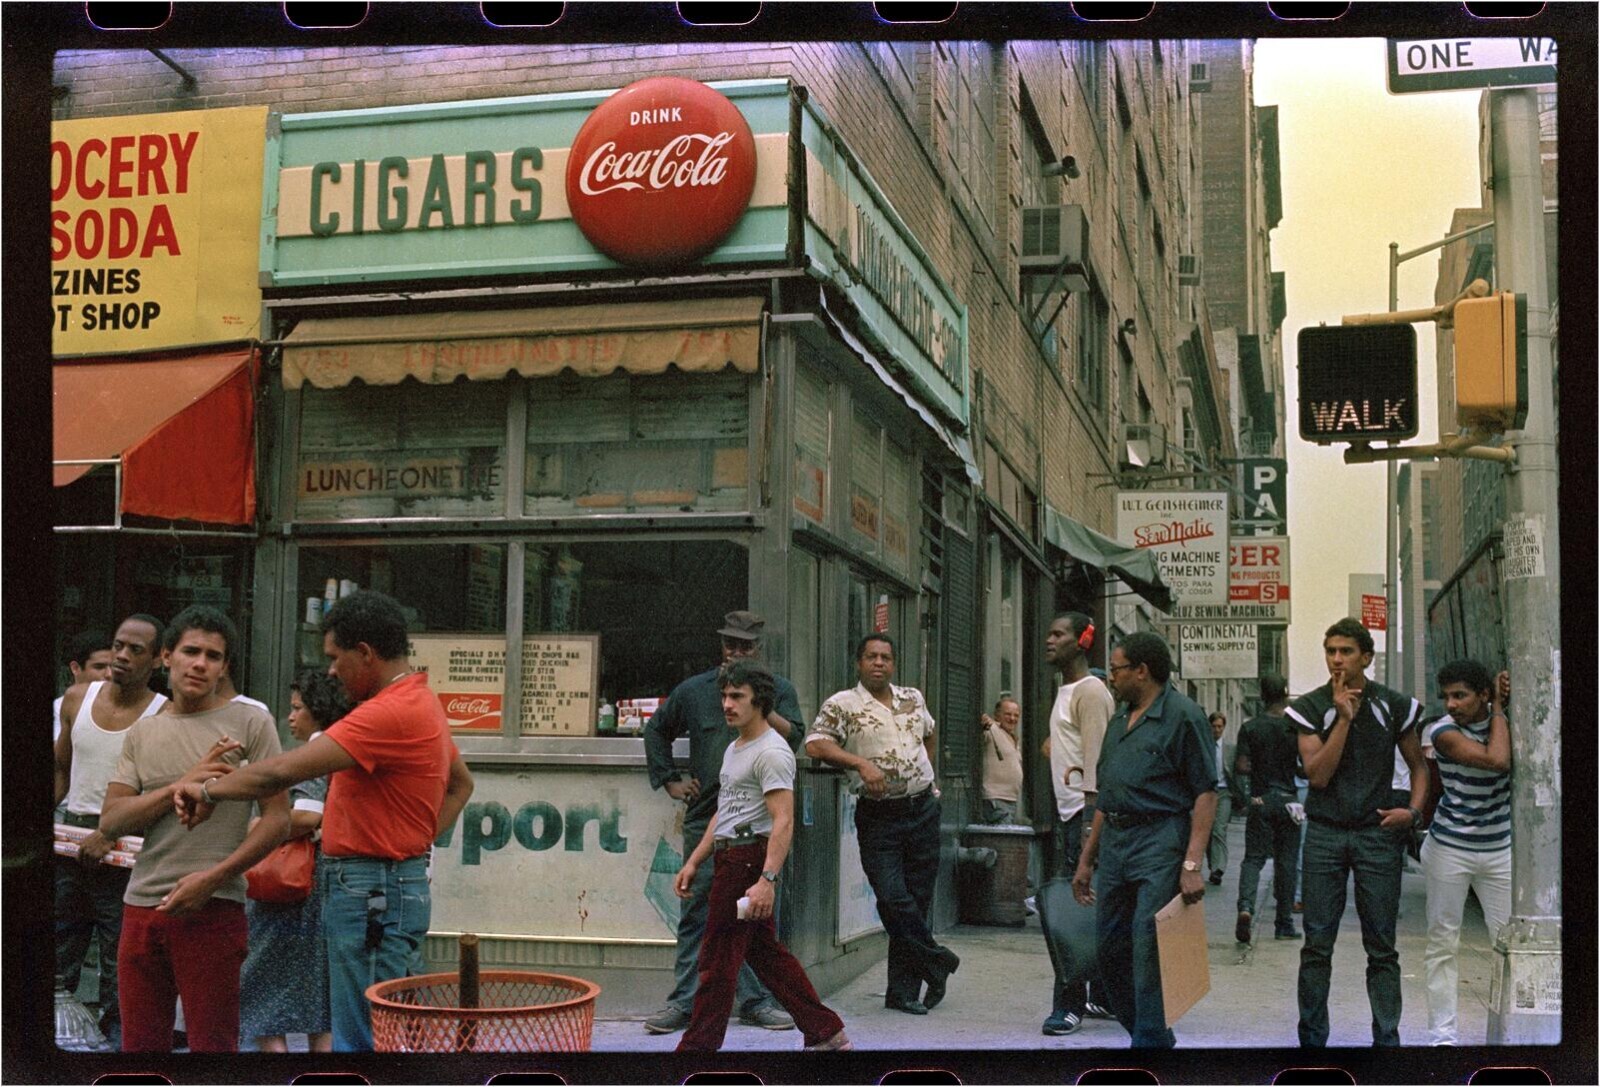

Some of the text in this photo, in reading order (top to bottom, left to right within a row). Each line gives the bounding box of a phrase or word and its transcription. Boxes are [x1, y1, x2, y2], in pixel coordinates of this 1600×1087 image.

[1407, 41, 1474, 71] ONE
[630, 107, 682, 127] DRINK
[579, 131, 737, 196] Coca-Cola
[310, 146, 543, 238] CIGARS
[50, 268, 141, 296] ZINES
[81, 301, 161, 331] SHOP
[1311, 399, 1405, 432] WALK
[1171, 551, 1221, 563] MACHINE
[1192, 580, 1213, 588] PARA
[1243, 570, 1281, 580] PRODUCTS
[1262, 584, 1276, 600] S
[1195, 605, 1229, 618] SEWING
[1231, 604, 1276, 617] MACHINES
[1181, 624, 1256, 640] CONTINENTAL
[1183, 641, 1216, 652] SEWING
[1217, 641, 1245, 651] SUPPLY
[447, 698, 491, 714] Coca-Cola
[435, 788, 628, 866] port
